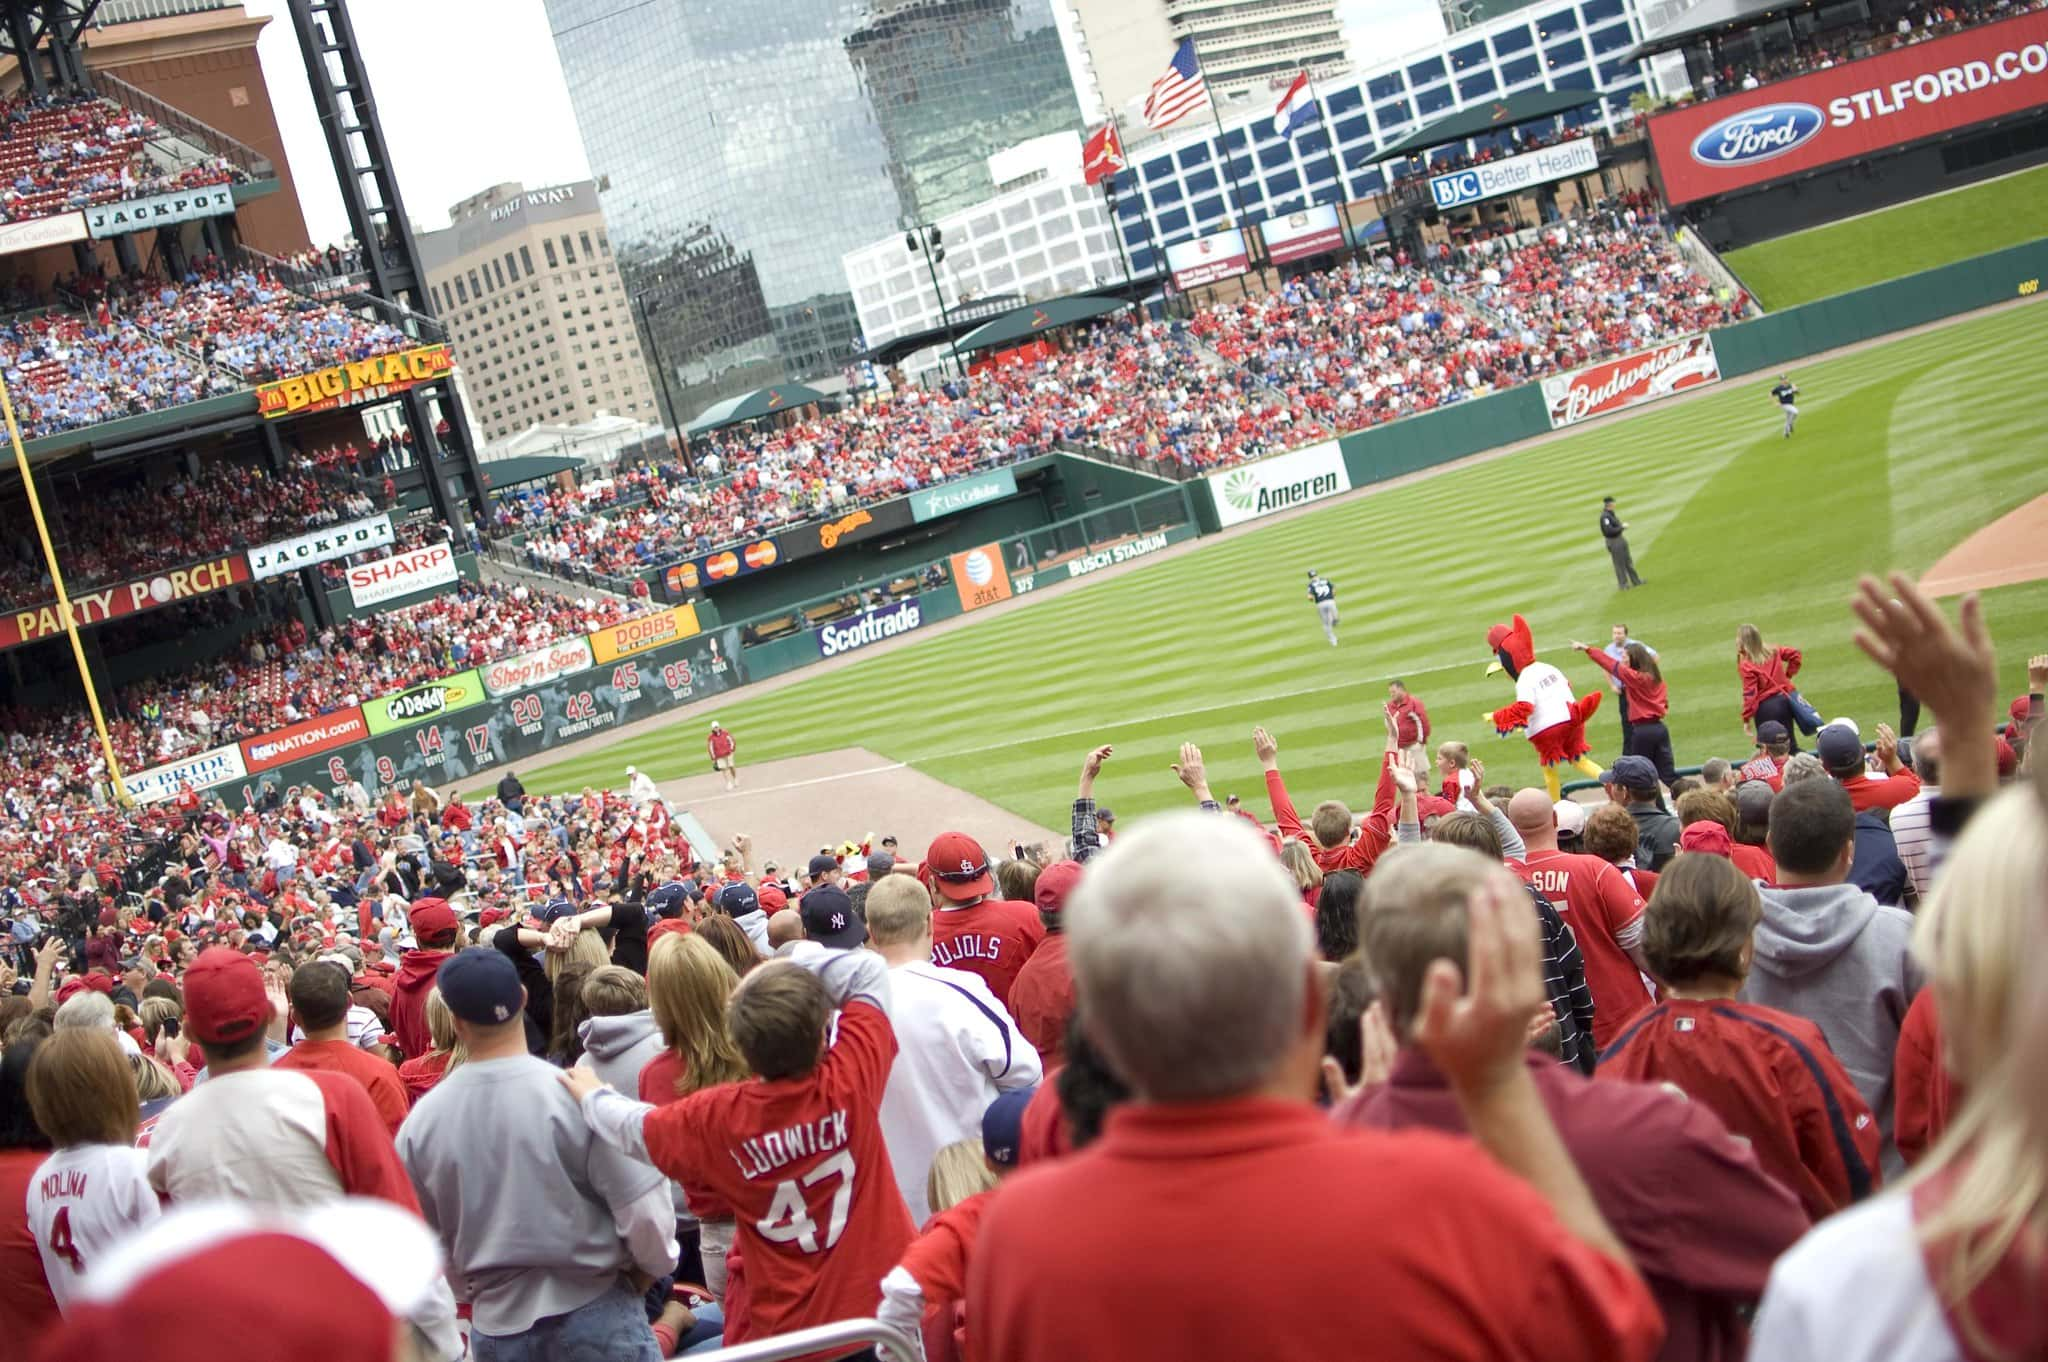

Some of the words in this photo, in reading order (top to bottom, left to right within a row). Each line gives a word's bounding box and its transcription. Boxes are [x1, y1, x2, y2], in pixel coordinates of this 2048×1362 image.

[1829, 40, 2048, 127] STLFORD.CO
[1719, 115, 1799, 158] Ford
[1435, 174, 1479, 205] BJC
[1481, 164, 1534, 191] Better
[1537, 145, 1594, 178] Health
[93, 192, 228, 228] JACKPOT
[526, 186, 575, 206] HYATT
[282, 366, 346, 412] BIG
[344, 350, 434, 391] MAC
[337, 384, 390, 408] LAND
[1564, 342, 1692, 424] Budweiser
[1257, 471, 1337, 512] Ameren
[256, 523, 388, 569] JACKPOT
[1068, 550, 1113, 577] BUSCH
[1115, 533, 1168, 563] STADIUM
[351, 548, 448, 589] SHARP
[974, 585, 1000, 605] at&t
[615, 614, 676, 645] DOBBS
[821, 603, 921, 657] Scottrade
[489, 662, 531, 690] Shop
[548, 648, 587, 670] Save
[612, 661, 641, 691] 45
[663, 659, 692, 689] 85
[511, 694, 544, 726] 20
[566, 691, 597, 721] 42
[416, 725, 445, 757] 14
[465, 724, 489, 755] 17
[328, 754, 348, 785] 6
[376, 755, 396, 784] 9
[1532, 870, 1570, 892] SON
[729, 1109, 848, 1180] LUDWICK
[41, 1169, 88, 1203] MOLINA
[756, 1148, 857, 1254] 47
[49, 1206, 87, 1276] 4
